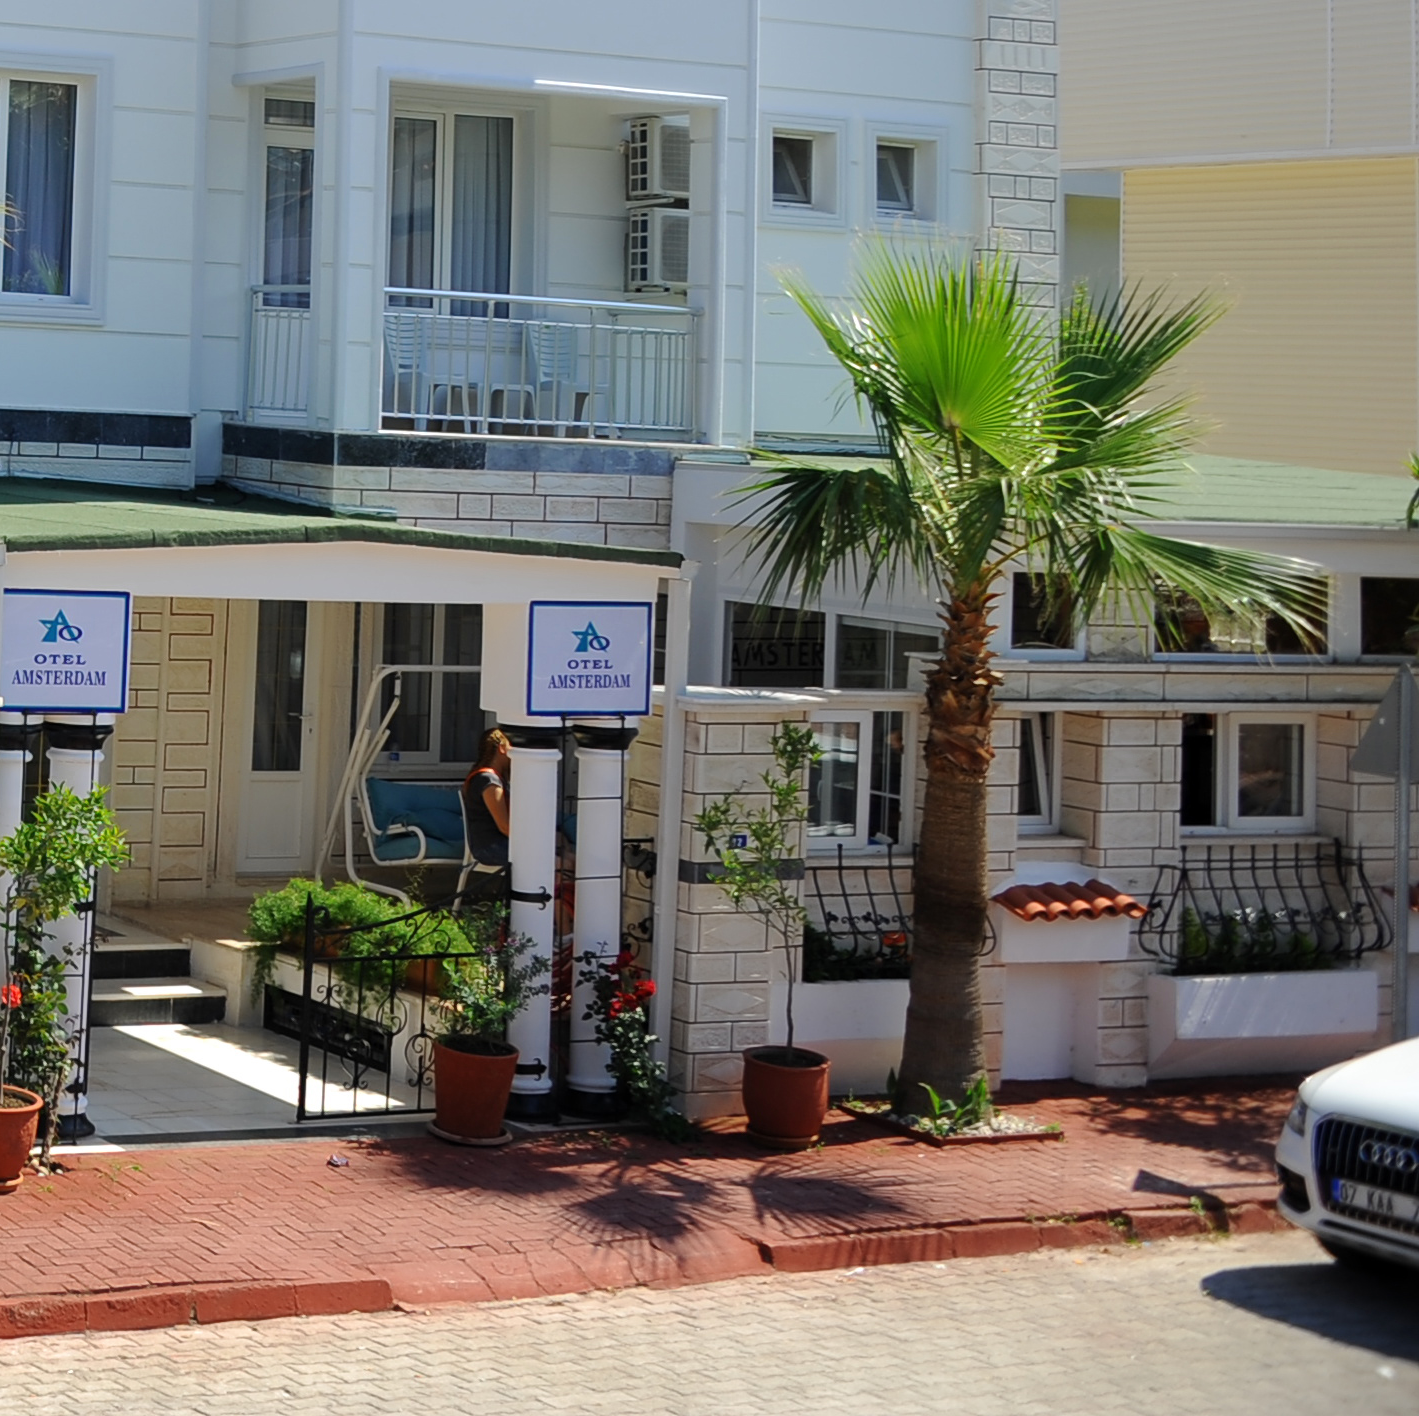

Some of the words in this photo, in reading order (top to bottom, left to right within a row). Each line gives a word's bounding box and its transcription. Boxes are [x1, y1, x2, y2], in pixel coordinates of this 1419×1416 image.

[33, 653, 87, 666] OTEL
[731, 641, 879, 668] AMSTERAM
[567, 659, 614, 670] OTEL
[11, 669, 107, 686] AMSTERDAM
[547, 674, 631, 689] AMSTERDAM
[1366, 1188, 1394, 1216] KAA
